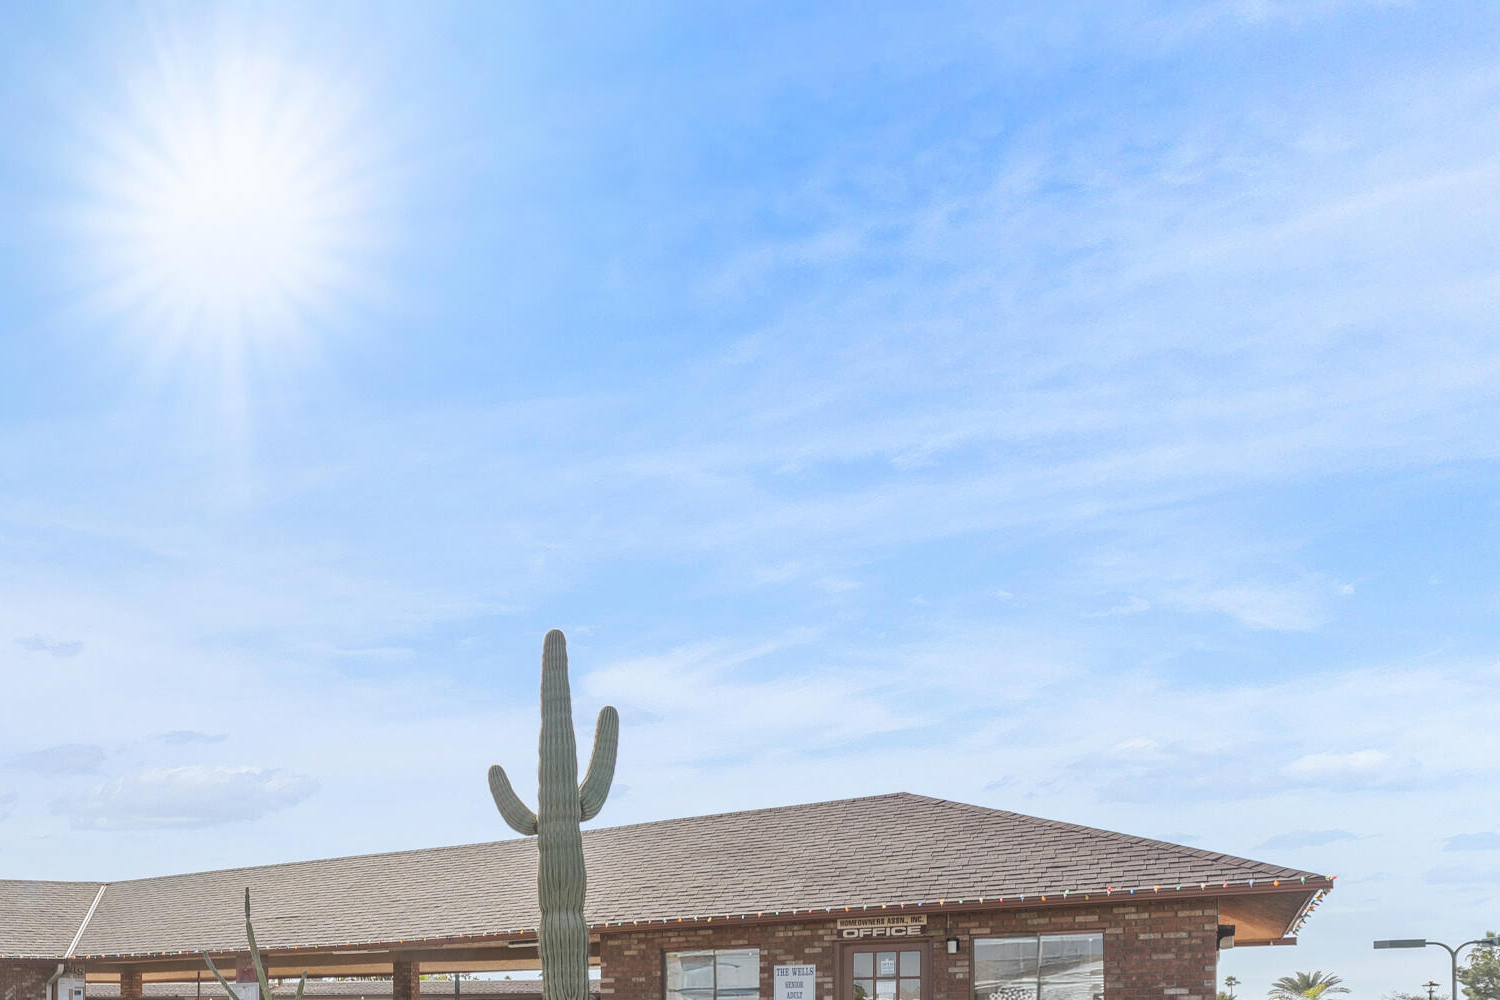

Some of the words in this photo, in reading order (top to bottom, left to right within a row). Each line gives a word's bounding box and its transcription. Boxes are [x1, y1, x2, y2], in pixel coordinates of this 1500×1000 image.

[840, 918, 885, 927] HOMEOWNERS
[911, 916, 925, 924] INC.
[842, 925, 921, 938] OFFICE
[776, 967, 790, 977] THE
[792, 967, 814, 976] WELLS
[786, 991, 803, 999] ADULT
